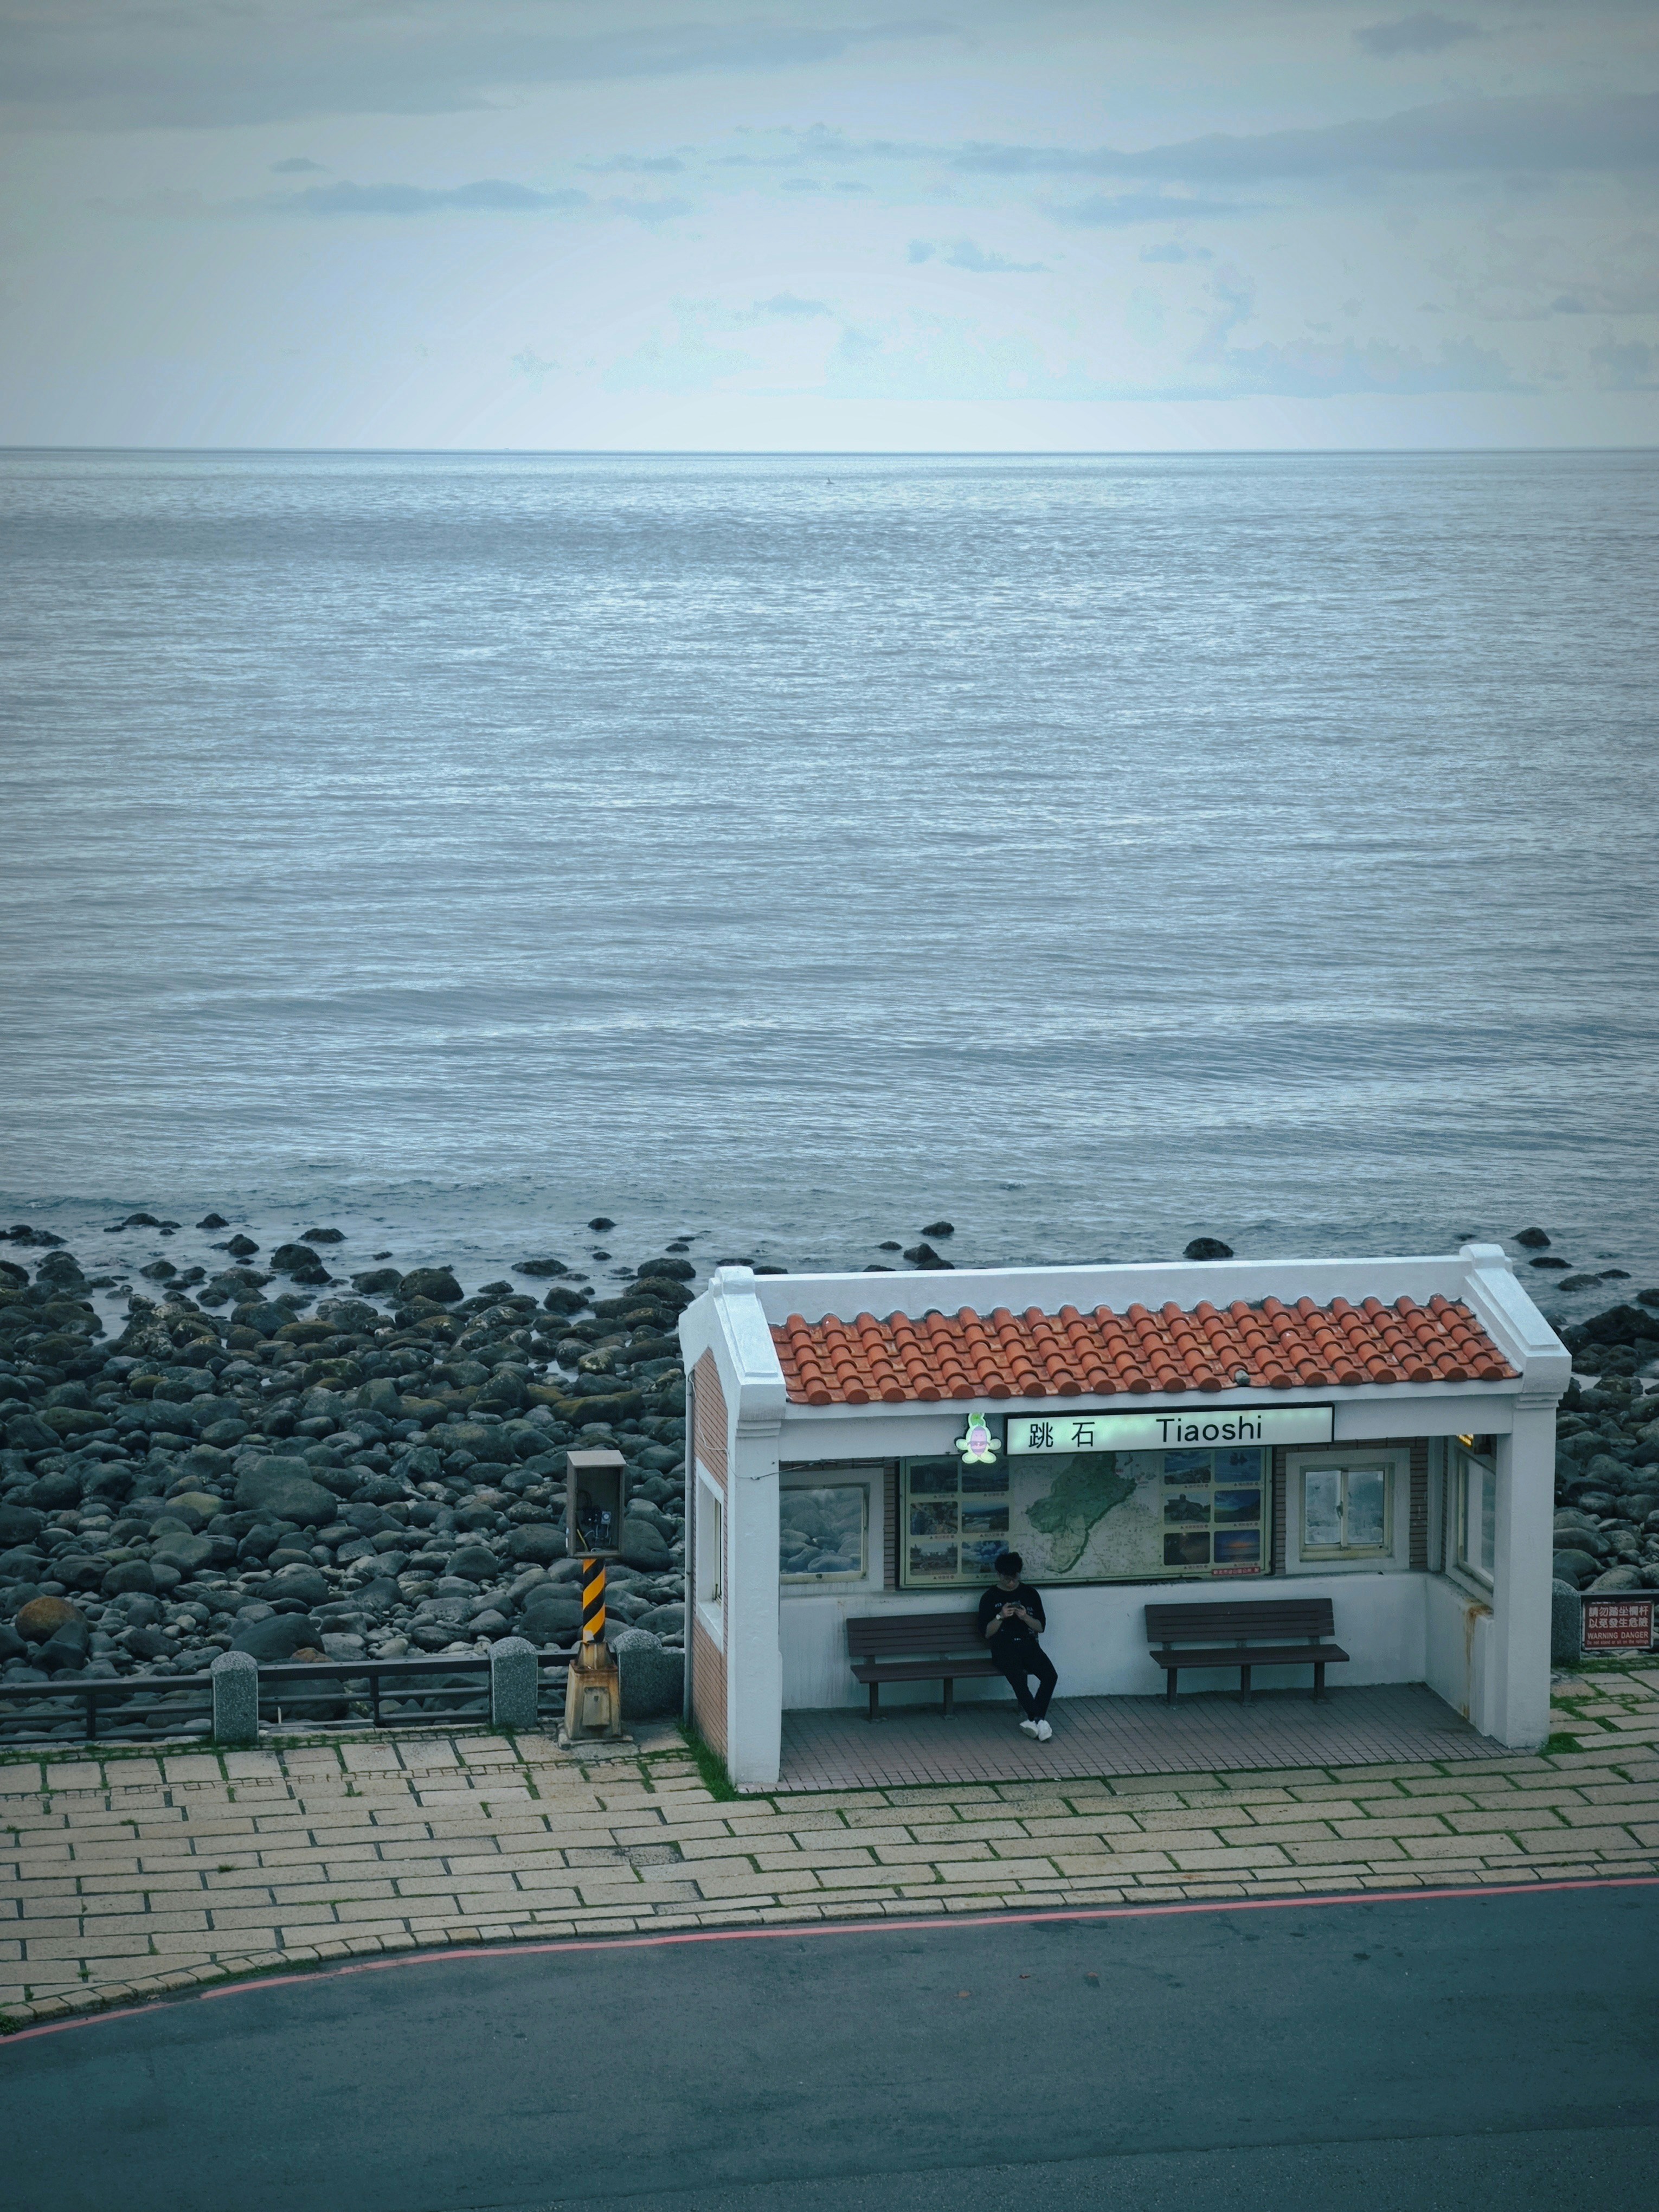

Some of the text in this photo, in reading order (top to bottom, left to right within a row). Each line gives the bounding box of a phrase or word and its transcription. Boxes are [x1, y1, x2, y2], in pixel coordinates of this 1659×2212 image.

[1028, 1422, 1096, 1449] 跳石
[1156, 1416, 1262, 1443] Tiaoshi
[1588, 1617, 1649, 1628] 以免發生危險
